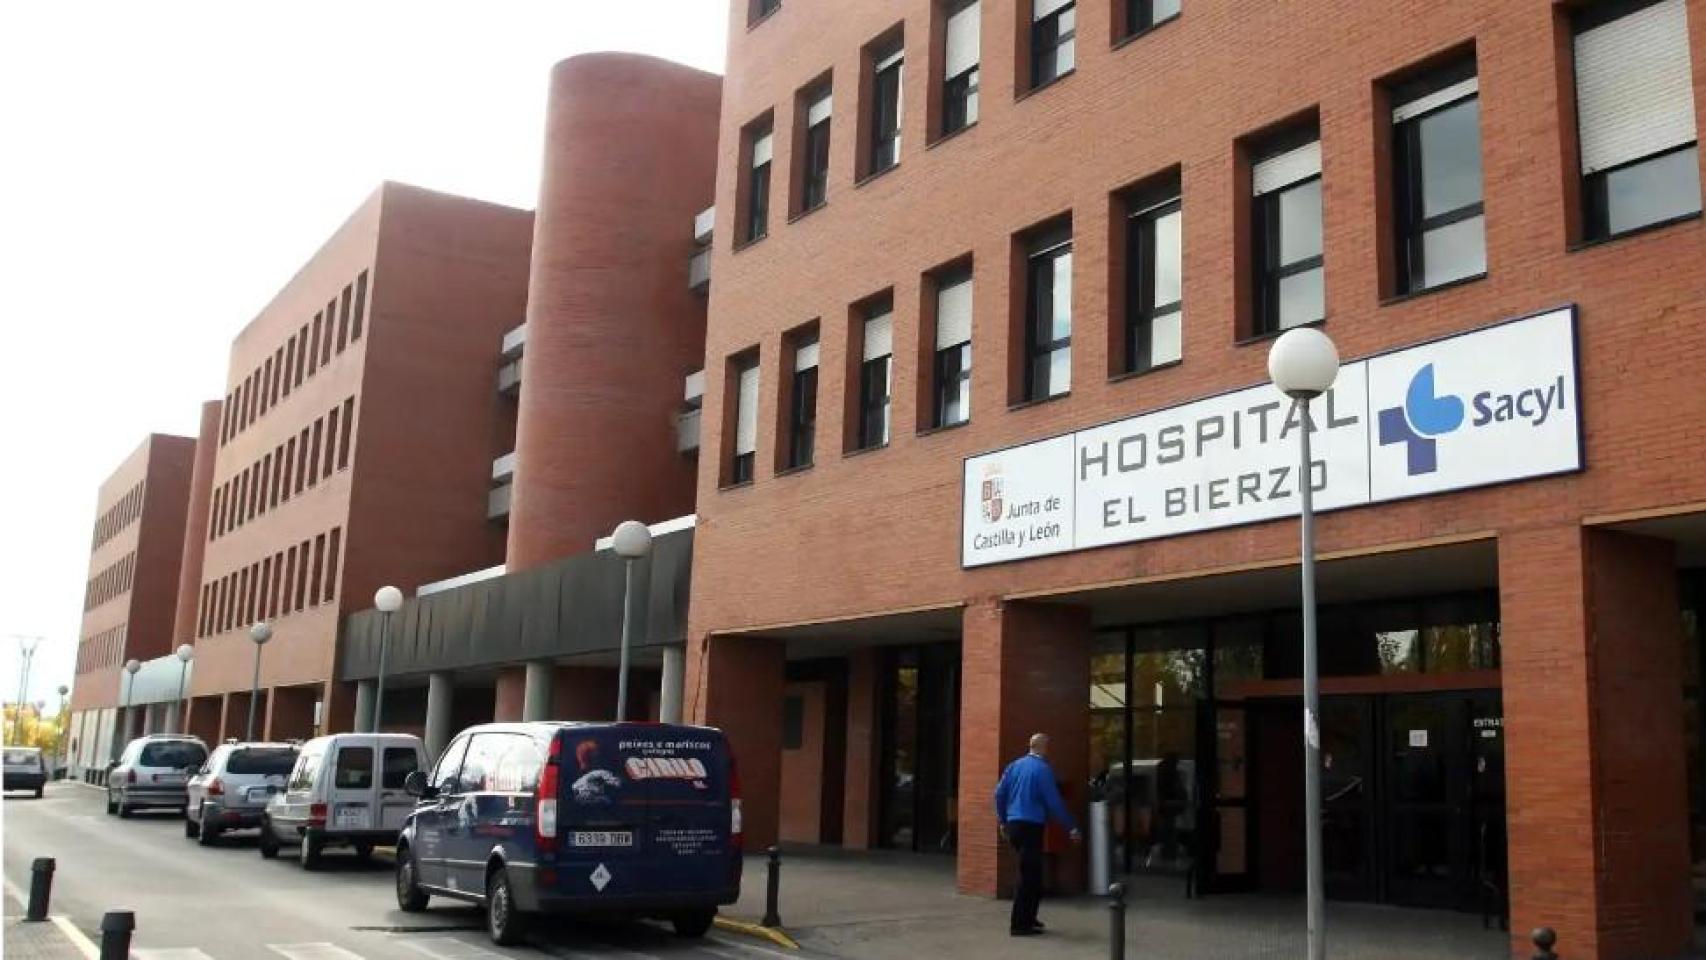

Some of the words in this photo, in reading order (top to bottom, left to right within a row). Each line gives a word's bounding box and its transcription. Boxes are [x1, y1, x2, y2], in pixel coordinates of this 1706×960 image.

[1472, 375, 1564, 427] Sacyl
[1080, 388, 1359, 482] HOSPITAL
[1007, 502, 1040, 520] Junta
[1044, 494, 1060, 512] de
[1103, 496, 1147, 529] EL
[1164, 459, 1328, 518] BIERZO
[974, 528, 1016, 550] Castilla
[1017, 529, 1026, 549] y
[1029, 521, 1060, 542] León
[1473, 718, 1505, 728] ENTRA
